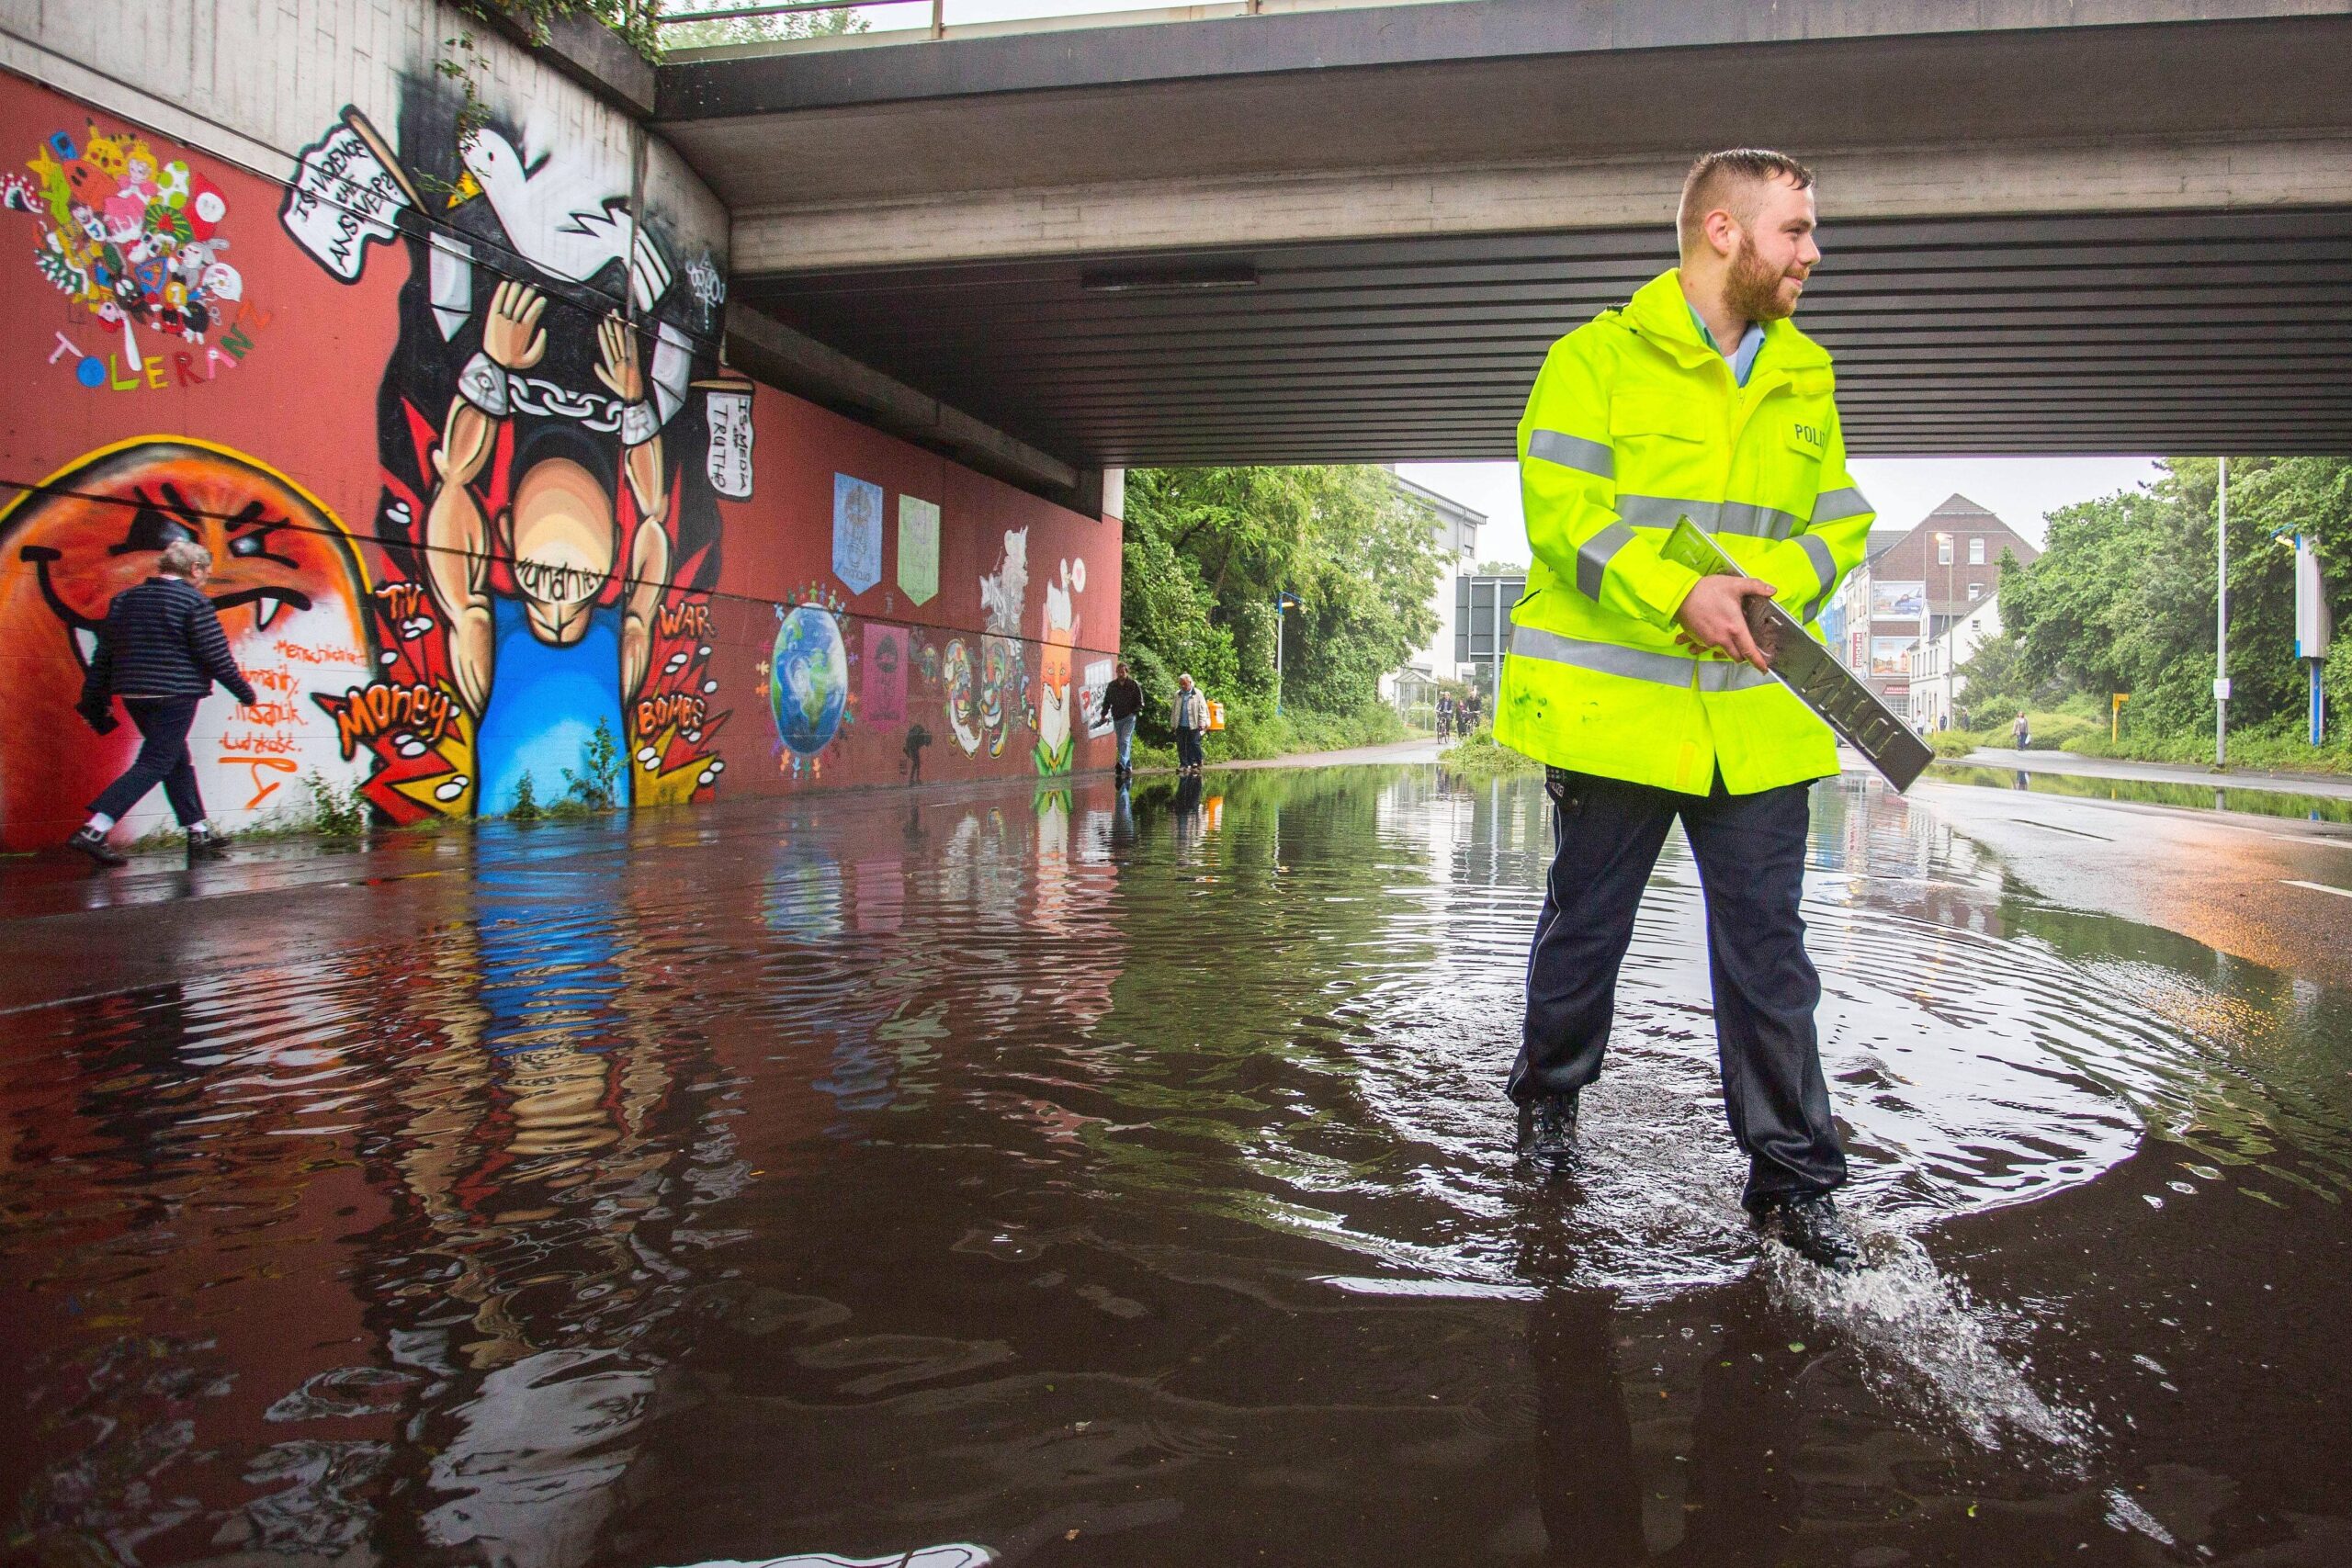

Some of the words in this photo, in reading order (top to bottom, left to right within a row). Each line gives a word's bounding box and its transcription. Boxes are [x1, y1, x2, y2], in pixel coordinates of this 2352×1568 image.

[49, 299, 273, 391] TOLERANZ
[375, 582, 424, 620] TV
[659, 603, 717, 638] WAR
[638, 694, 707, 736] BOMBS
